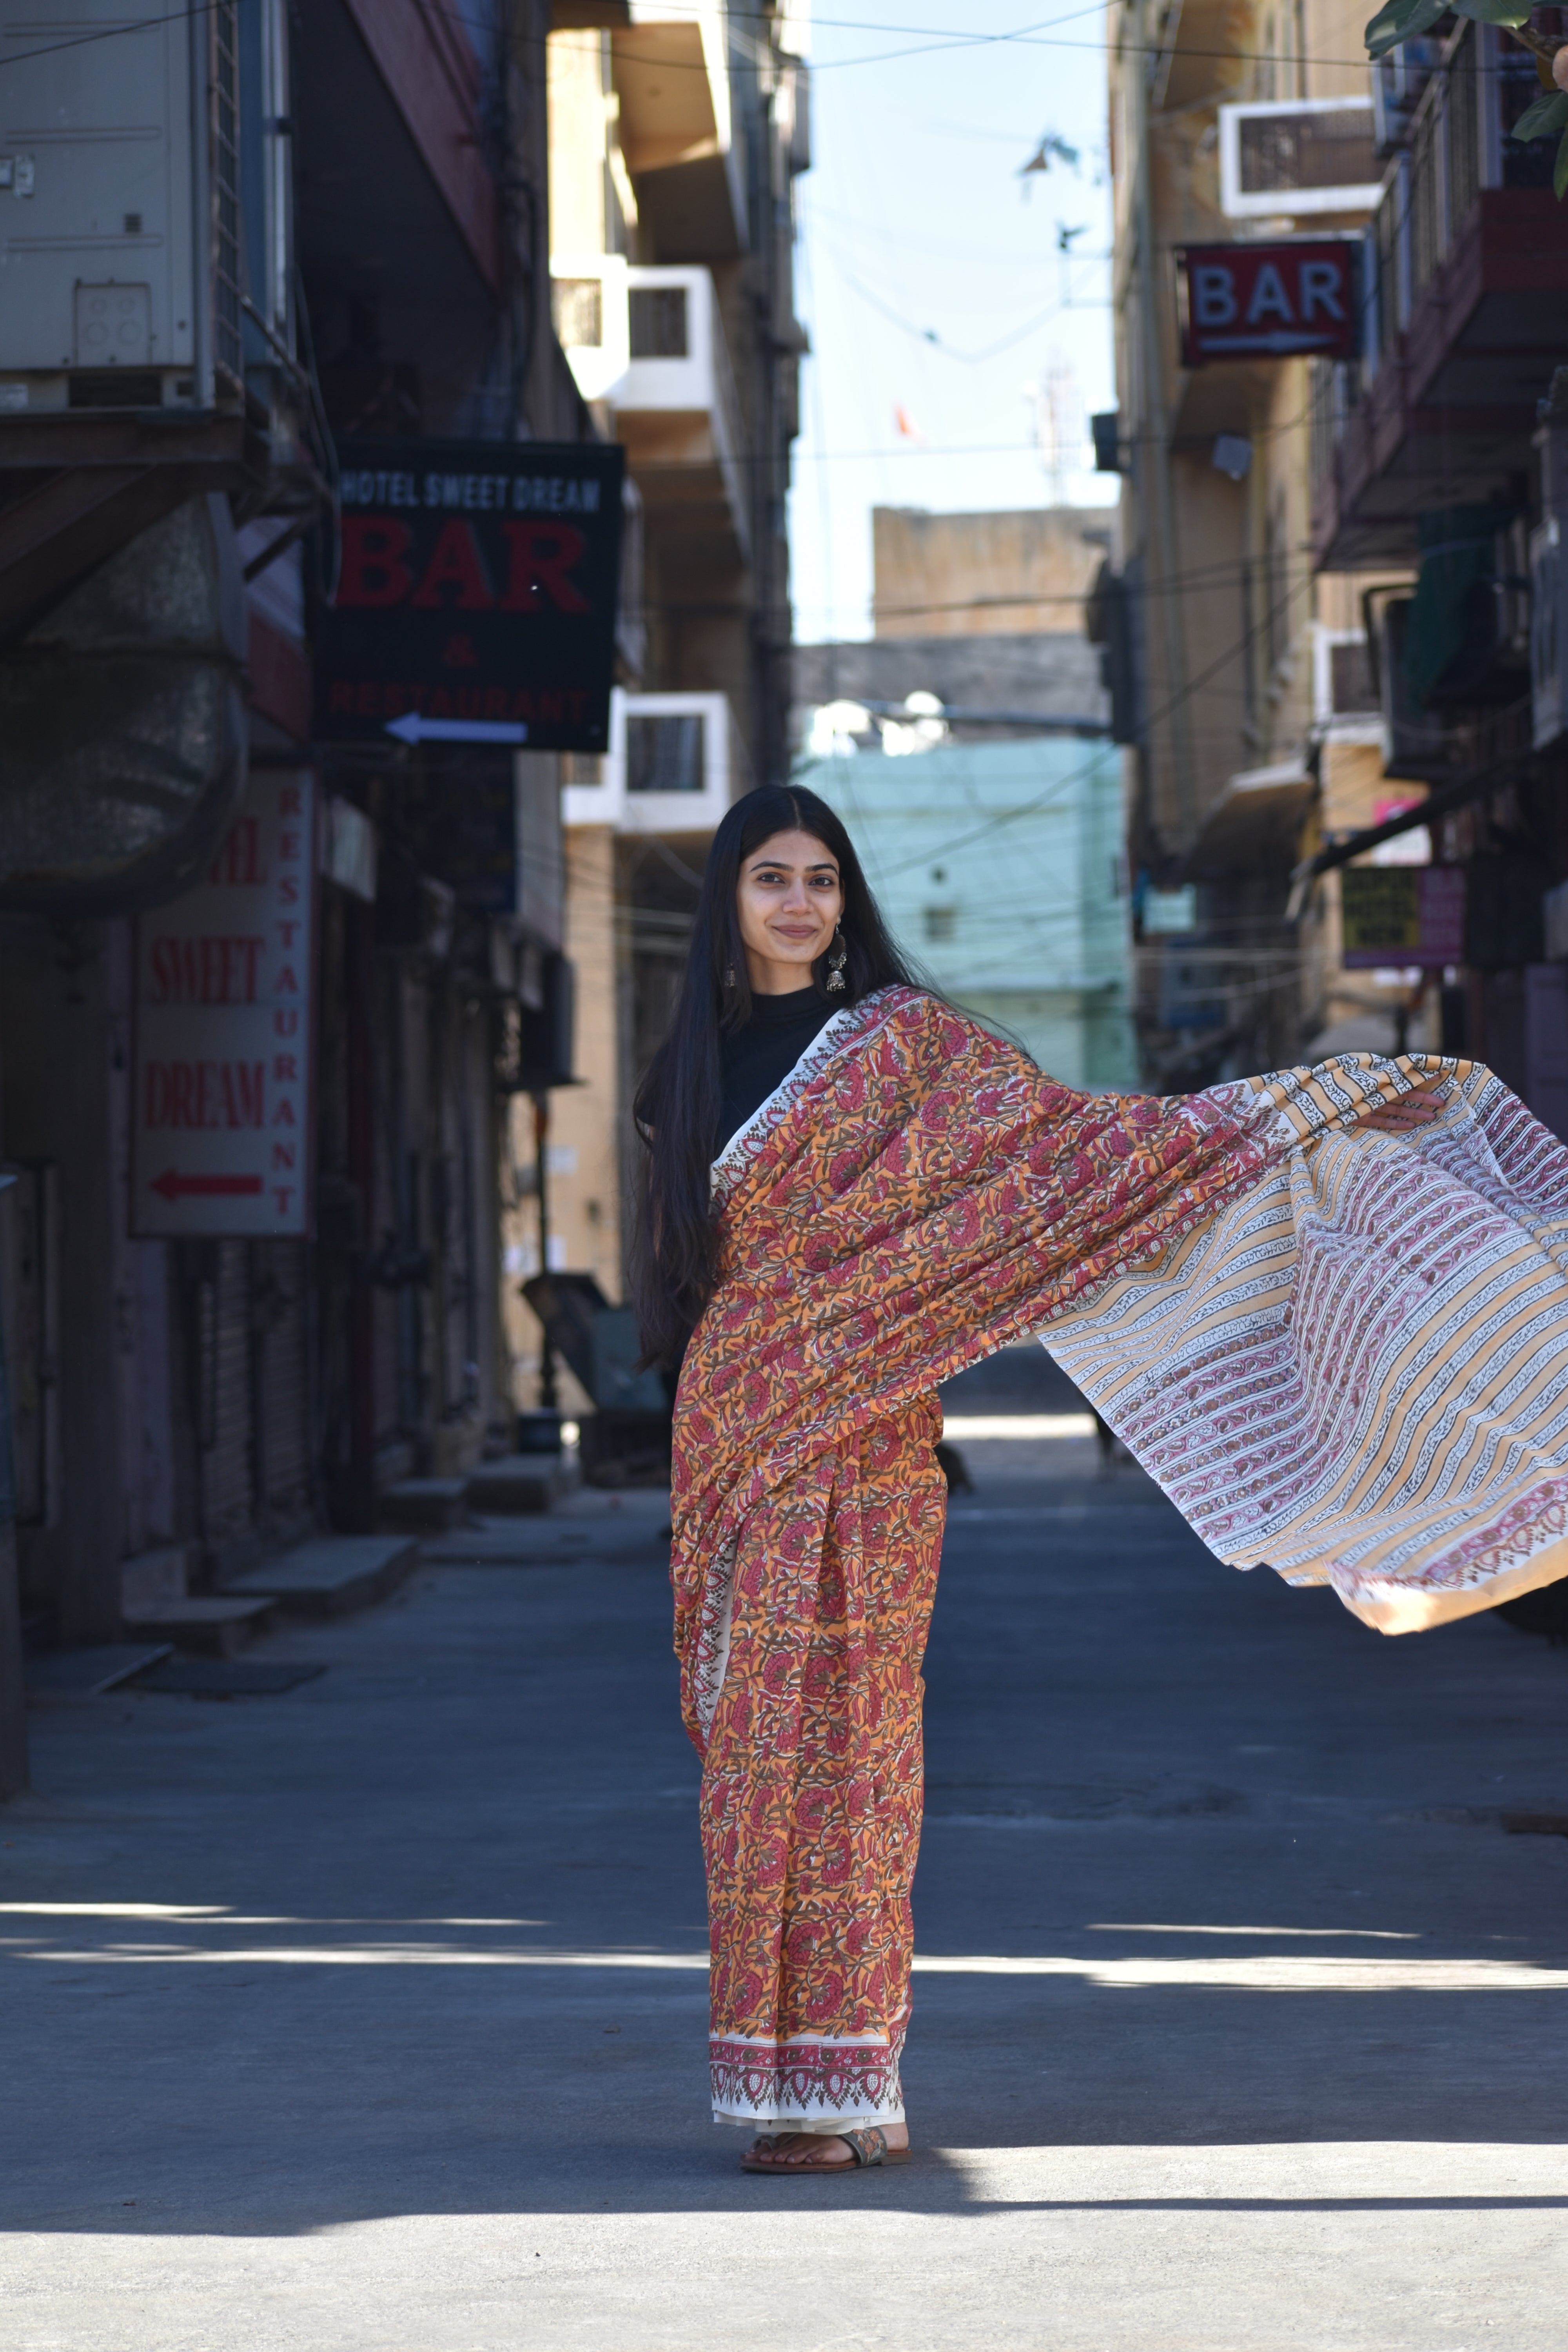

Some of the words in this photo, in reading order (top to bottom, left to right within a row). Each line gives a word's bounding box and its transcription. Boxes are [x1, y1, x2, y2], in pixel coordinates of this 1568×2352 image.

[1193, 260, 1346, 326] BAR
[339, 469, 419, 507] HOTEL
[423, 472, 510, 510] SWEET
[513, 476, 601, 513] DREAM
[336, 514, 590, 612] BAR
[441, 633, 479, 668] &
[328, 681, 590, 724] RESTAURANT
[150, 935, 265, 1005] SWEET
[272, 787, 304, 1215] RESTAURANT
[145, 1059, 266, 1130] DREAM
